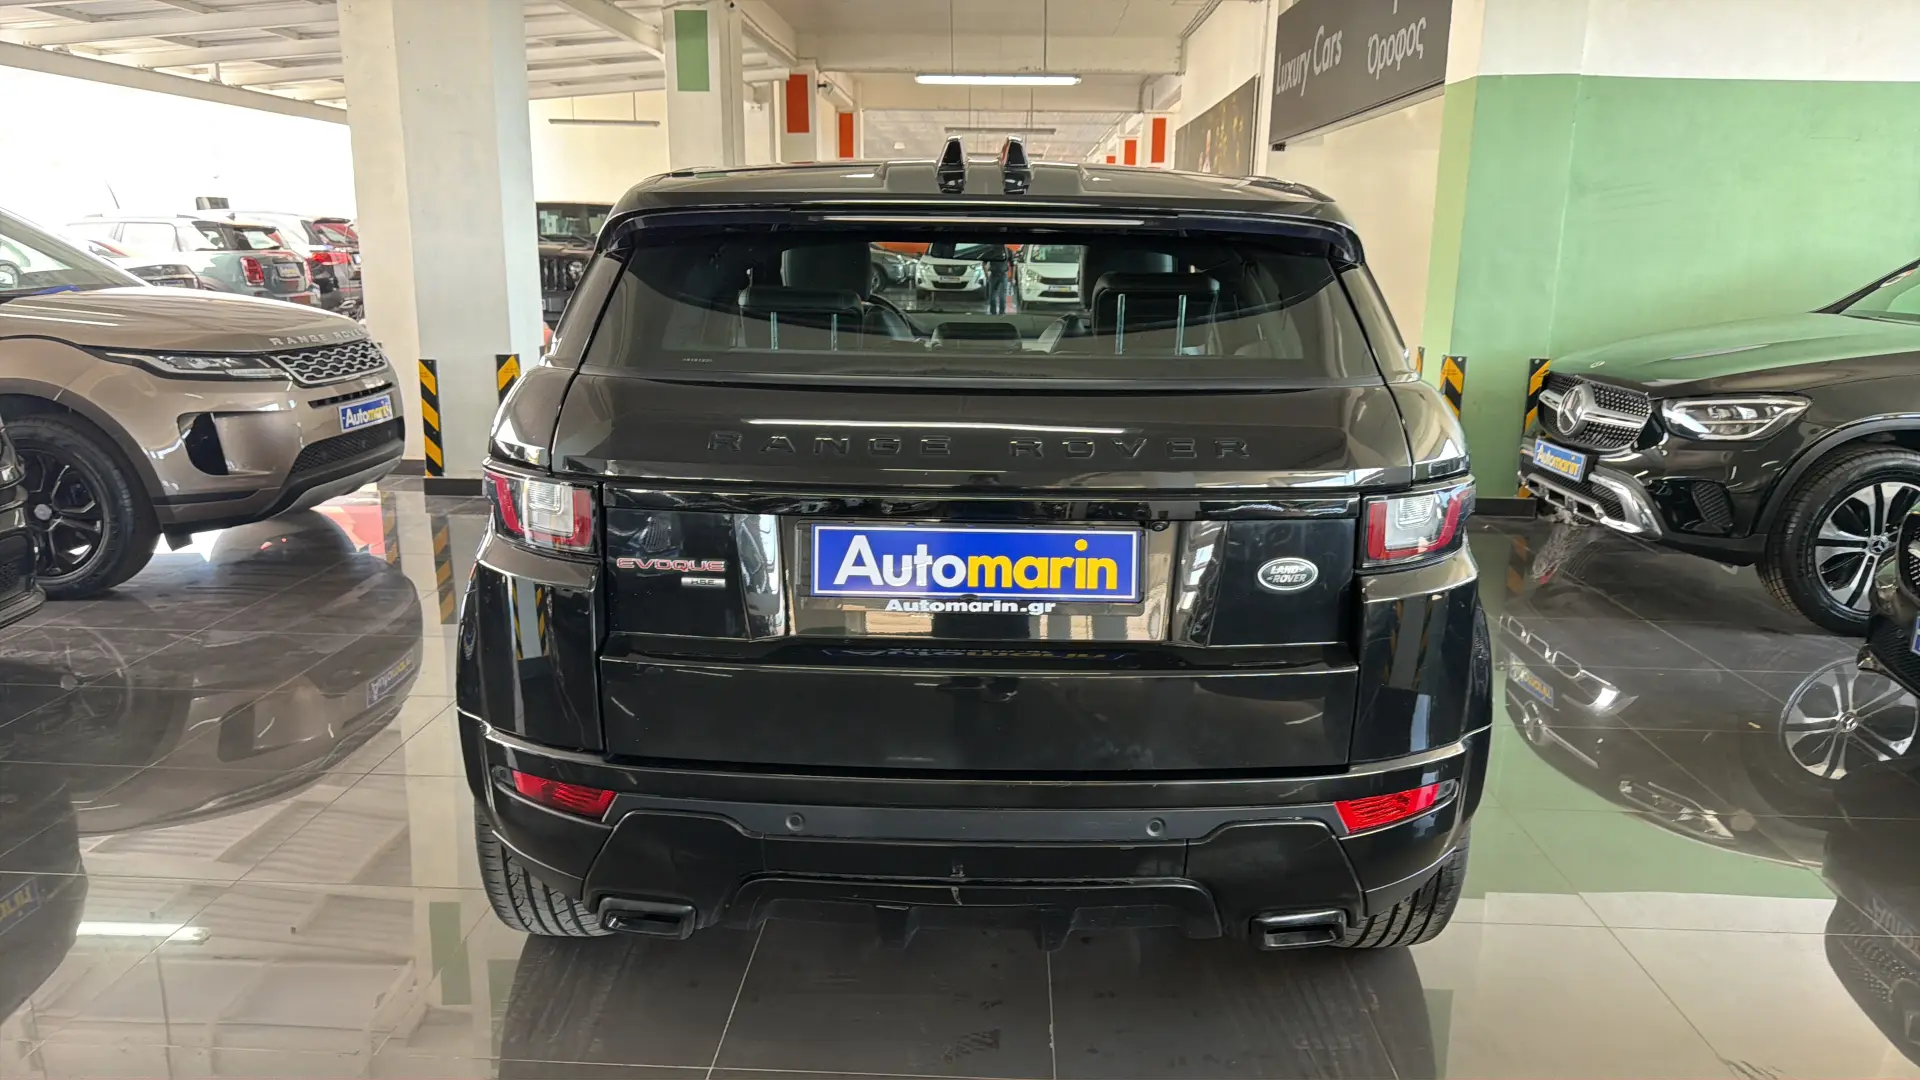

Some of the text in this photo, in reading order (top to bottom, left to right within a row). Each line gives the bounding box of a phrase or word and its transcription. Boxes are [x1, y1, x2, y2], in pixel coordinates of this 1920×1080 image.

[1275, 24, 1343, 97] Luxury Cars
[268, 333, 329, 346] RANGE
[708, 431, 1250, 459] RANGE ROVER
[616, 557, 726, 573] EVOQUE
[833, 534, 1118, 590] Automarin
[1270, 565, 1300, 575] LAND
[1272, 574, 1308, 583] ROVER
[884, 599, 1056, 615] Automarin.gr
